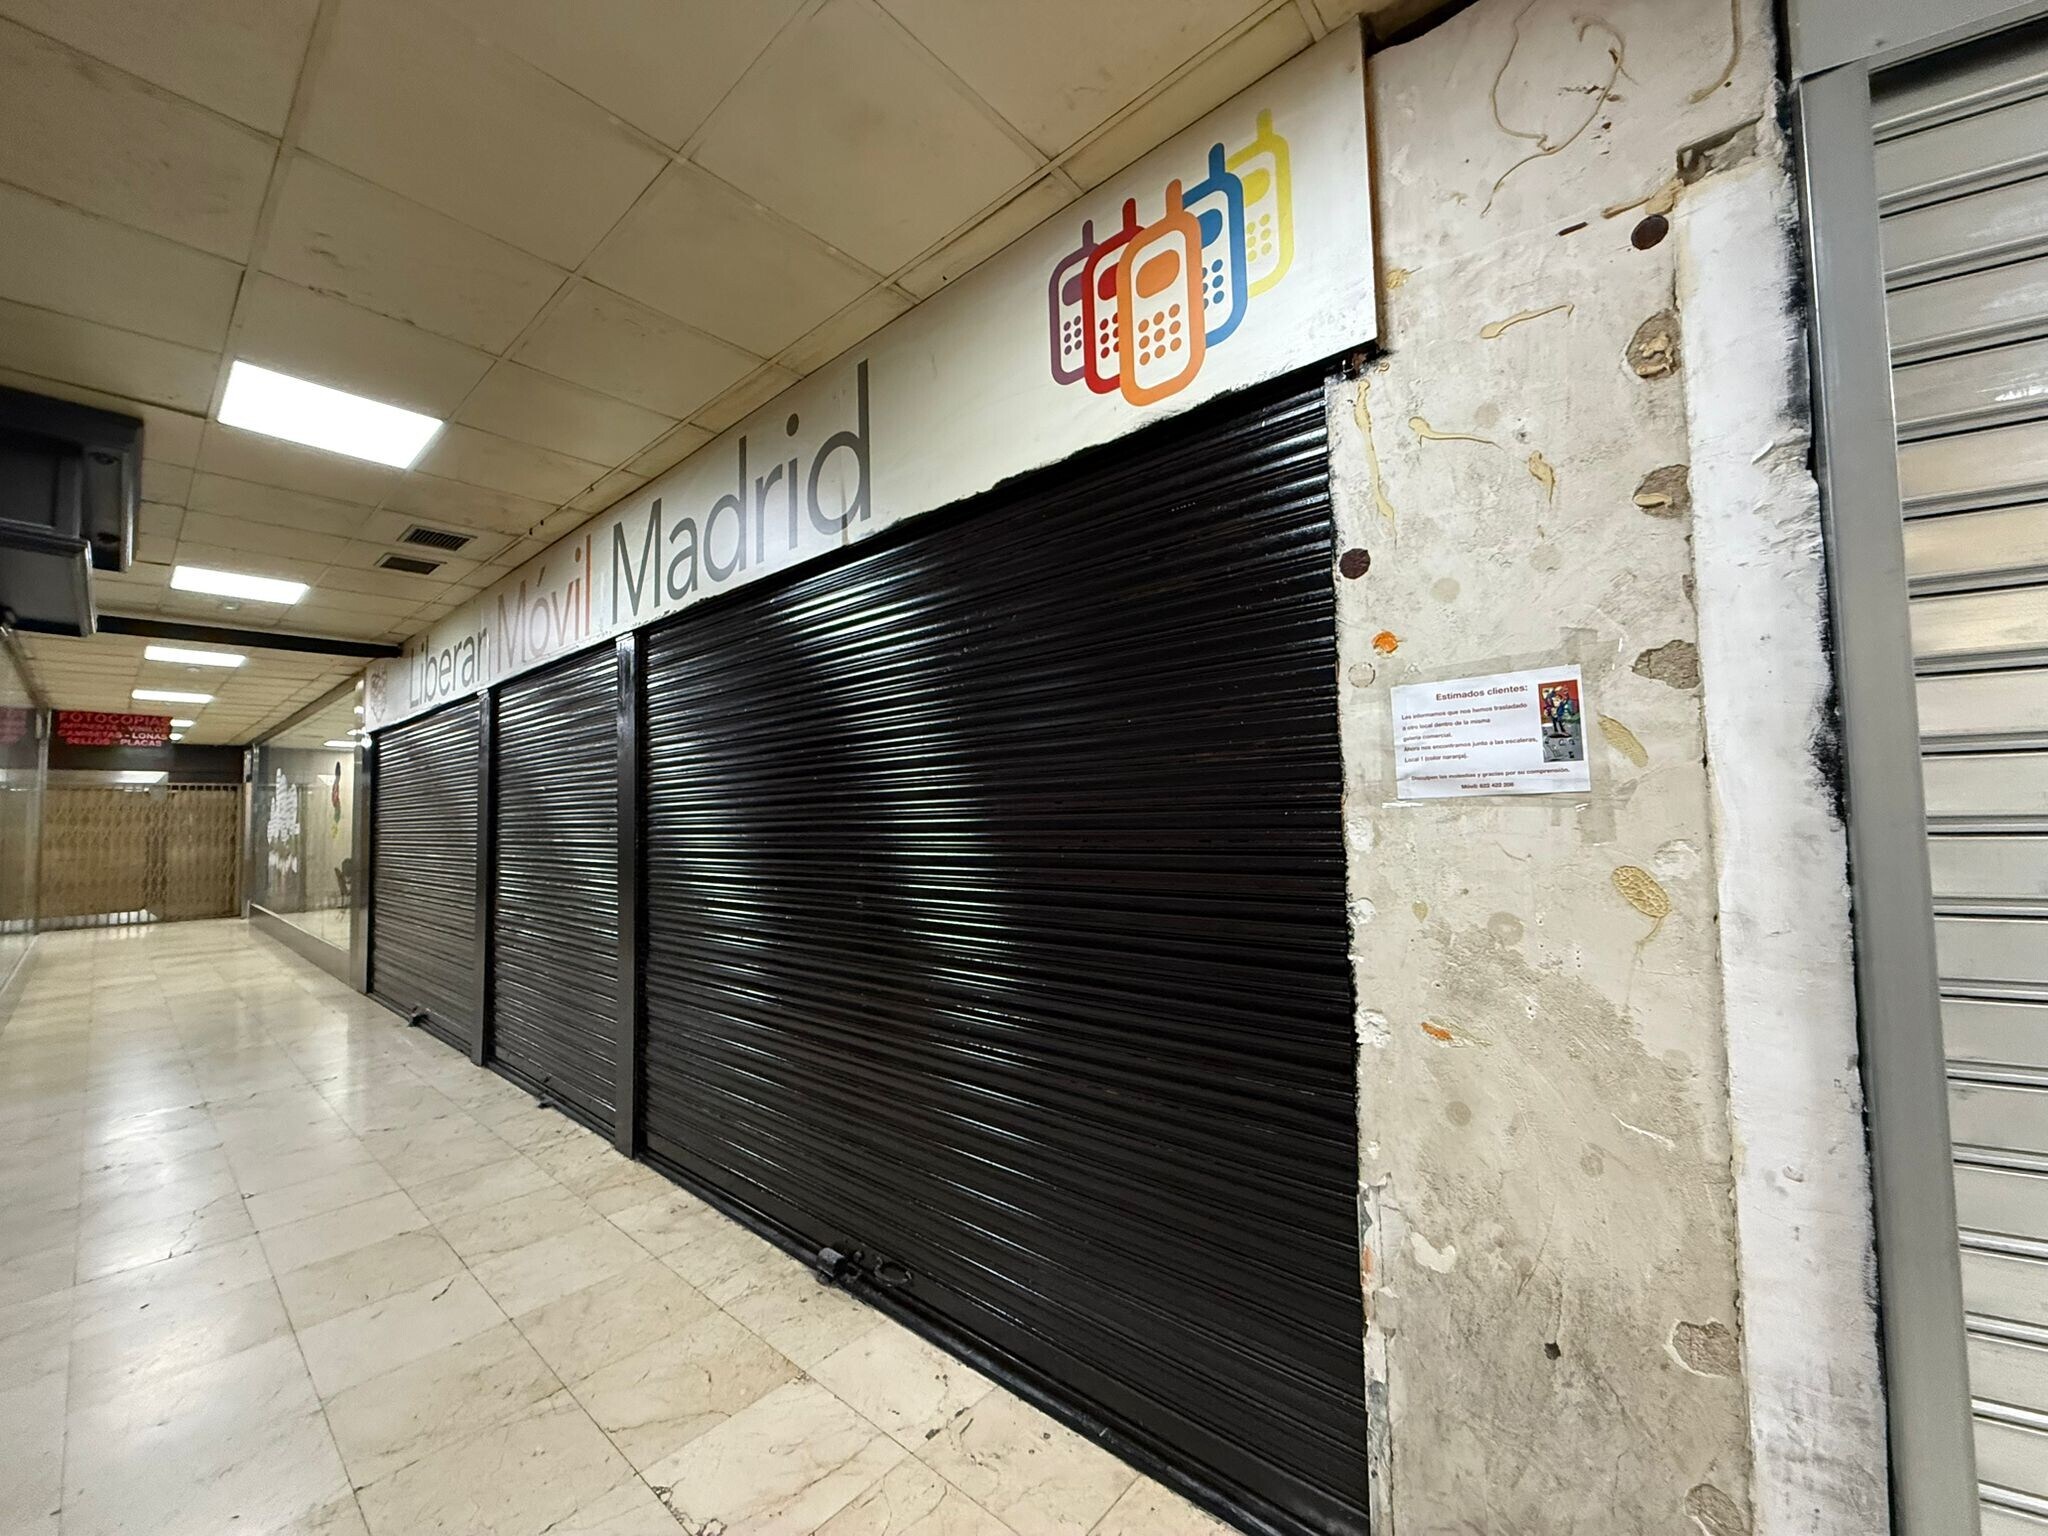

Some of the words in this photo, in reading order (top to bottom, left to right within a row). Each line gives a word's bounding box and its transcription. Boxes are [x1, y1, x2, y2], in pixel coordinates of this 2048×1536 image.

[497, 534, 592, 675] Móvil
[612, 358, 871, 625] Madrid
[1436, 690, 1485, 701] Estimados
[1487, 685, 1528, 696] clientes:
[59, 711, 168, 727] FOTOCOPIAS
[120, 738, 162, 746] PLACAS
[132, 732, 168, 740] LONAS
